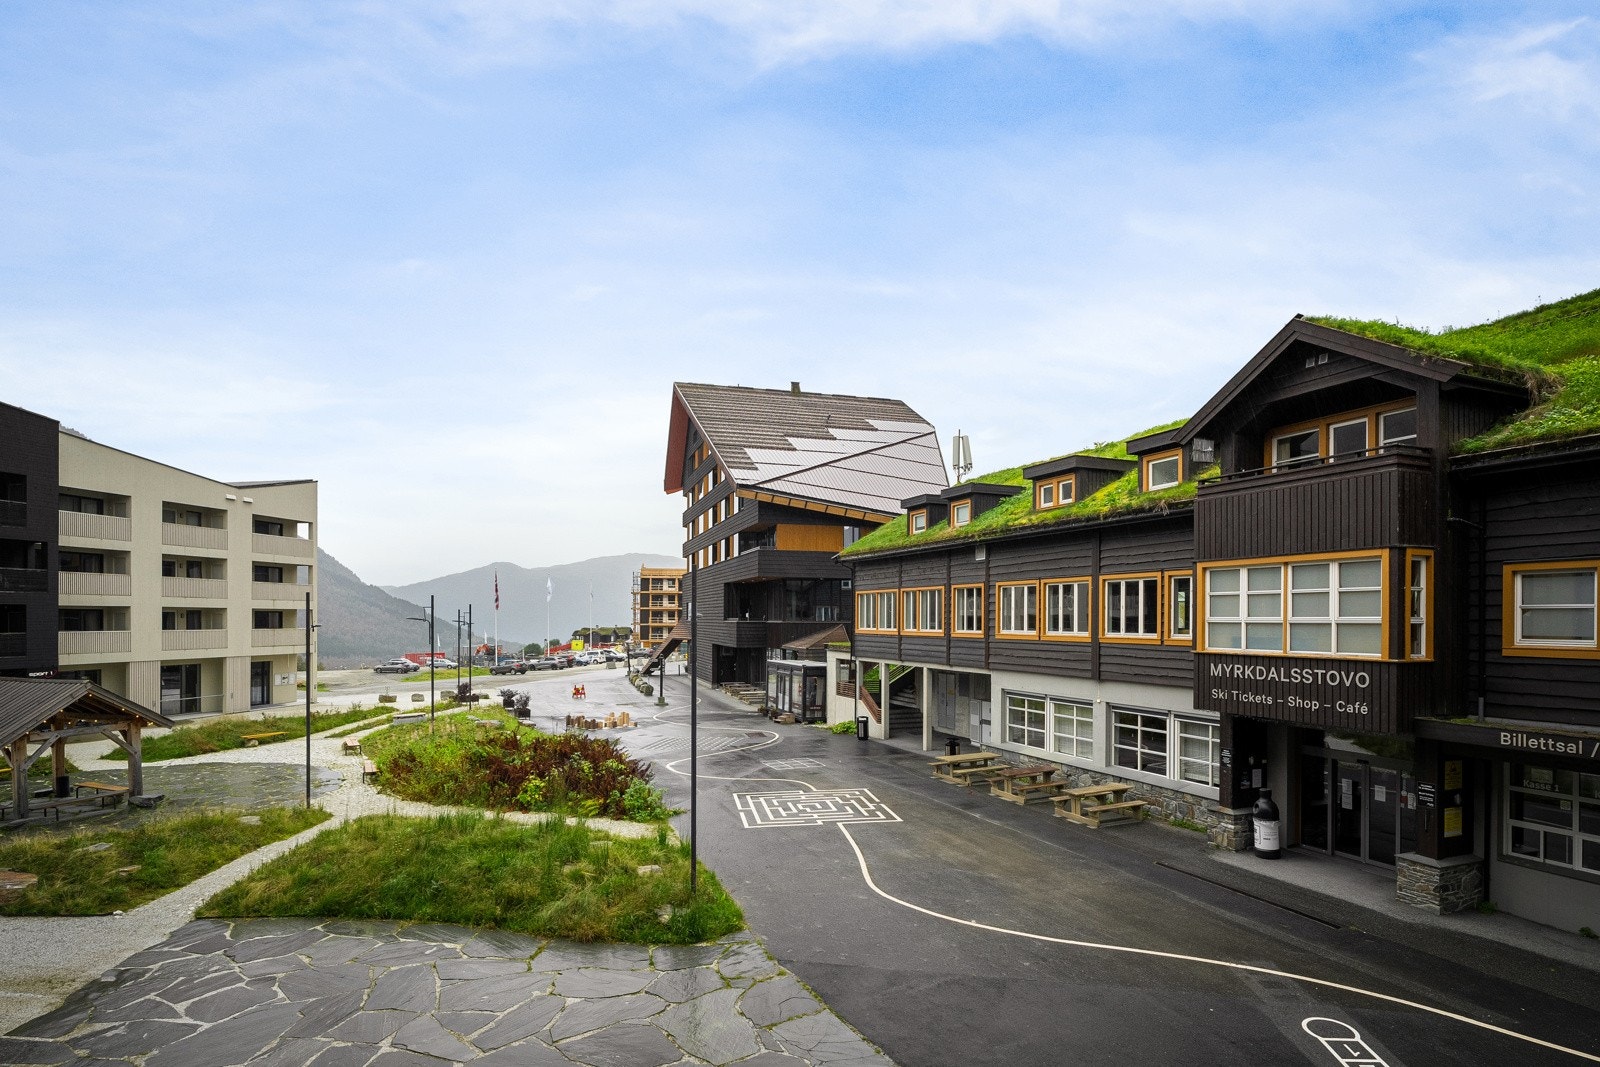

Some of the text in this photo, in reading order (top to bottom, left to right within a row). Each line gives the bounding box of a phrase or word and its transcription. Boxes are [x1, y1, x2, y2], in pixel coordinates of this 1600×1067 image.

[1210, 663, 1370, 688] MYRKDALSSTOVO
[1211, 688, 1228, 700] Ski
[1231, 690, 1273, 704] Tickets
[1288, 695, 1319, 711] Shop
[1336, 700, 1368, 715] Café
[1500, 732, 1583, 754] Billettsal
[1523, 779, 1551, 790] Kasse
